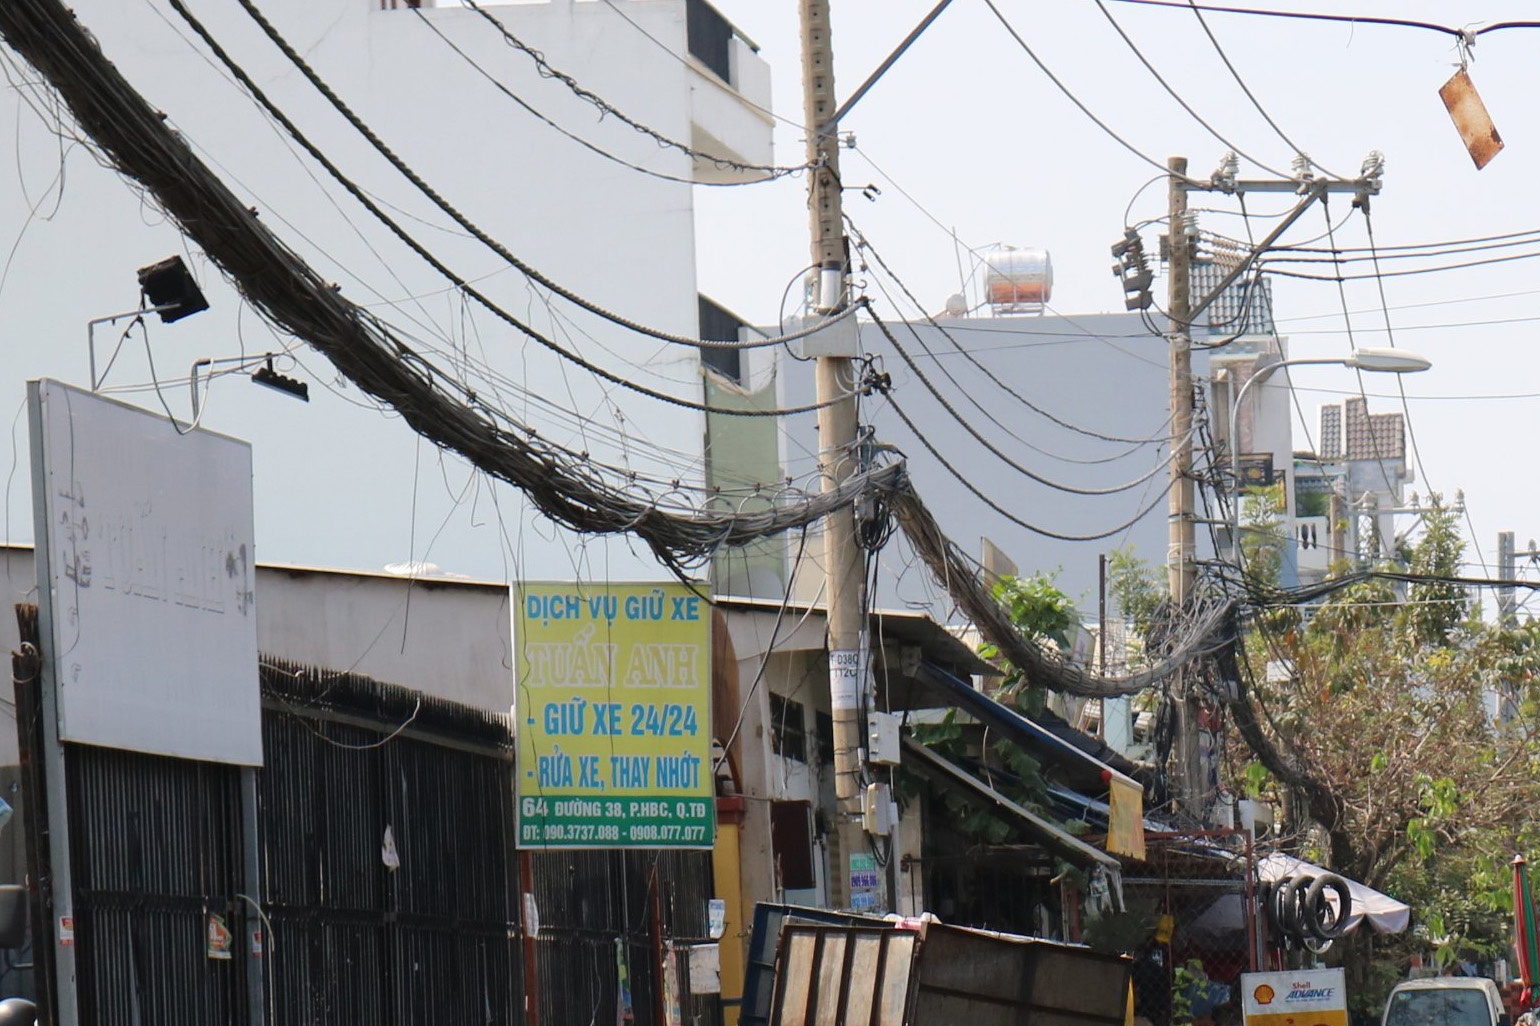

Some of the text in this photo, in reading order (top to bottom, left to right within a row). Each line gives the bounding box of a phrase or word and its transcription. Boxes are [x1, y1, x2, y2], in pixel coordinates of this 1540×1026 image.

[527, 589, 699, 627] DỊCH VỤ GIỮ XE
[527, 623, 698, 687] TUẤN ANH
[544, 697, 586, 735] GIỮ
[592, 703, 622, 735] XE
[631, 704, 698, 736] 24/24
[539, 745, 573, 787] RỬA
[578, 756, 605, 791] XE,
[610, 756, 650, 788] THAY
[656, 751, 700, 789] NHỚT
[523, 798, 706, 819] 64 ĐƯỜNG 38, P.HBC, Q.TĐ
[523, 825, 540, 840] ĐT:
[544, 825, 619, 841] 090.3737.088
[630, 826, 705, 841] 0908.077.077
[1284, 987, 1335, 1000] ADVANCE
[1292, 981, 1310, 989] Shell
